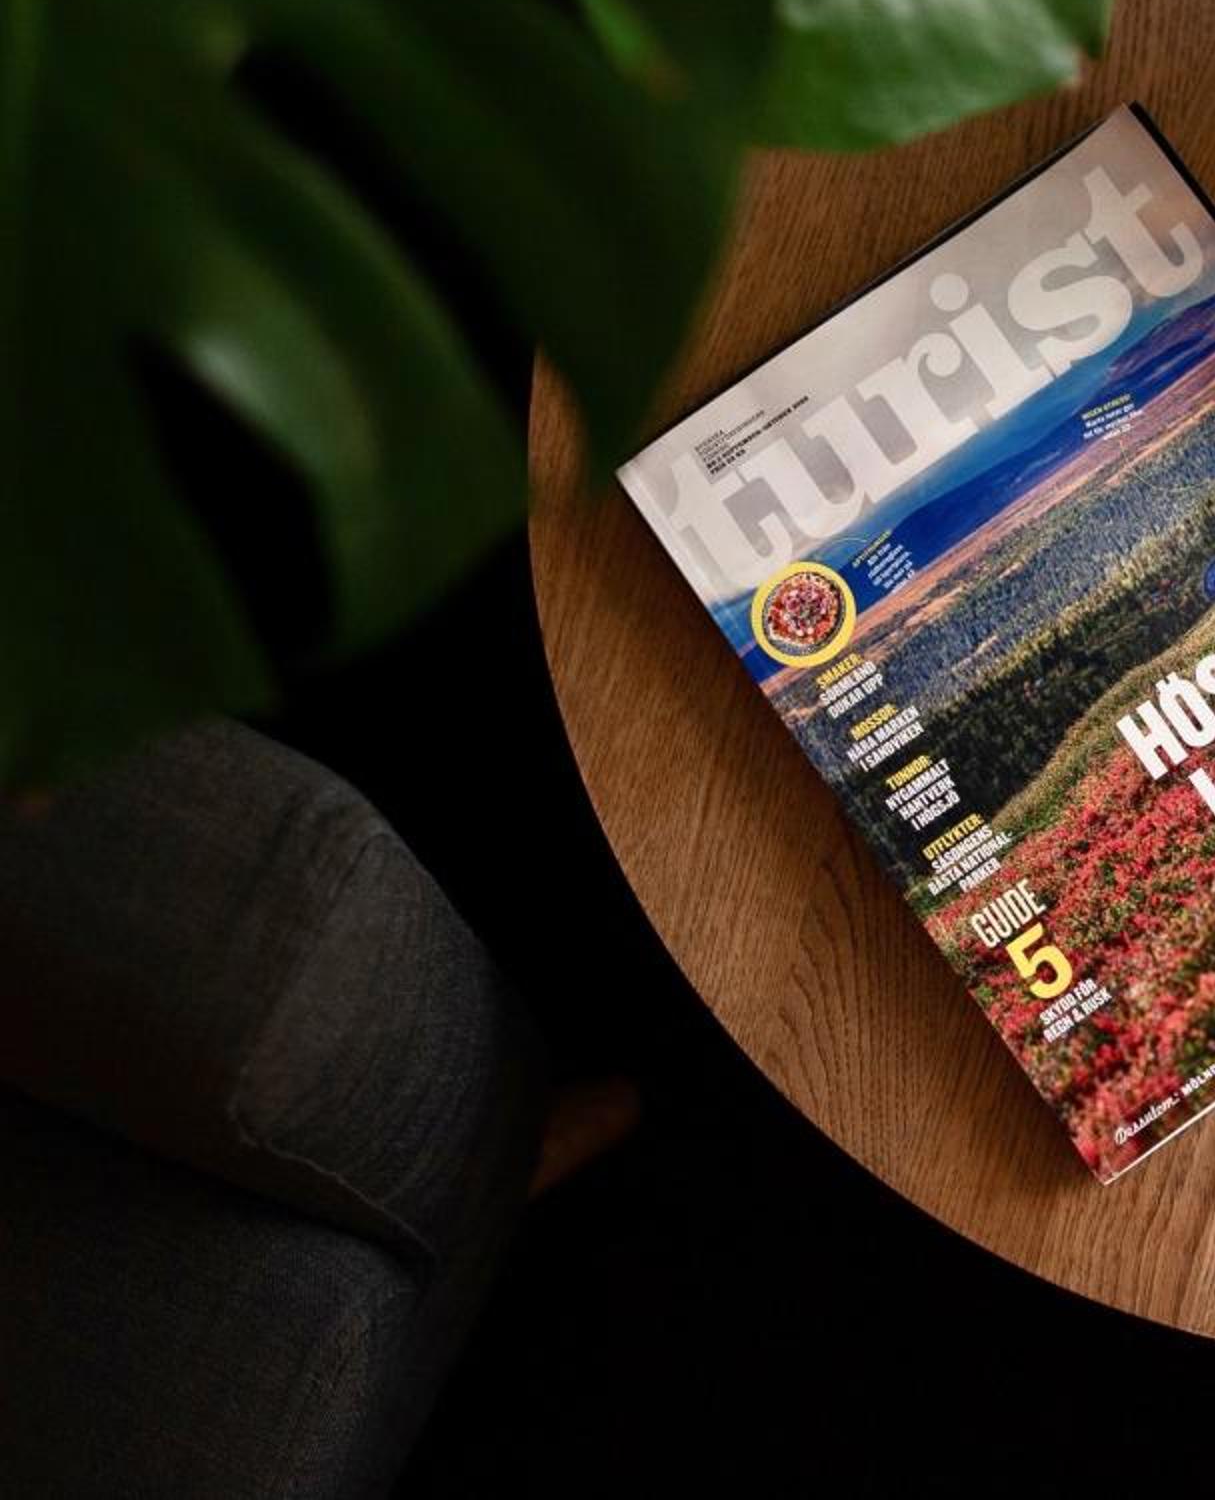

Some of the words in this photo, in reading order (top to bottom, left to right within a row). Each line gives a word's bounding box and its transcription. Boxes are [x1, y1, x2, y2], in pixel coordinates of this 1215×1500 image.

[667, 165, 1200, 588] turist
[827, 686, 865, 718] DUKAR
[861, 672, 885, 694] UPP
[859, 760, 868, 771] I
[864, 721, 924, 767] SANDVIKEN
[873, 705, 919, 742] MARKEN
[885, 758, 951, 809] NYGAMMALT
[898, 775, 954, 820] HANTVERK
[921, 811, 984, 860] UTFLYKTER:
[959, 828, 1014, 872] NATIONAL-
[957, 856, 1001, 892] PARKER
[967, 877, 1048, 949] GUIDE
[1004, 921, 1070, 996] 5
[1039, 992, 1078, 1024] SKYDD
[1071, 976, 1097, 1000] FÖR
[1042, 1014, 1074, 1042] REGN
[1070, 1007, 1084, 1021] &
[1080, 987, 1111, 1014] RUSK
[1115, 1091, 1181, 1144] Dessutom:
